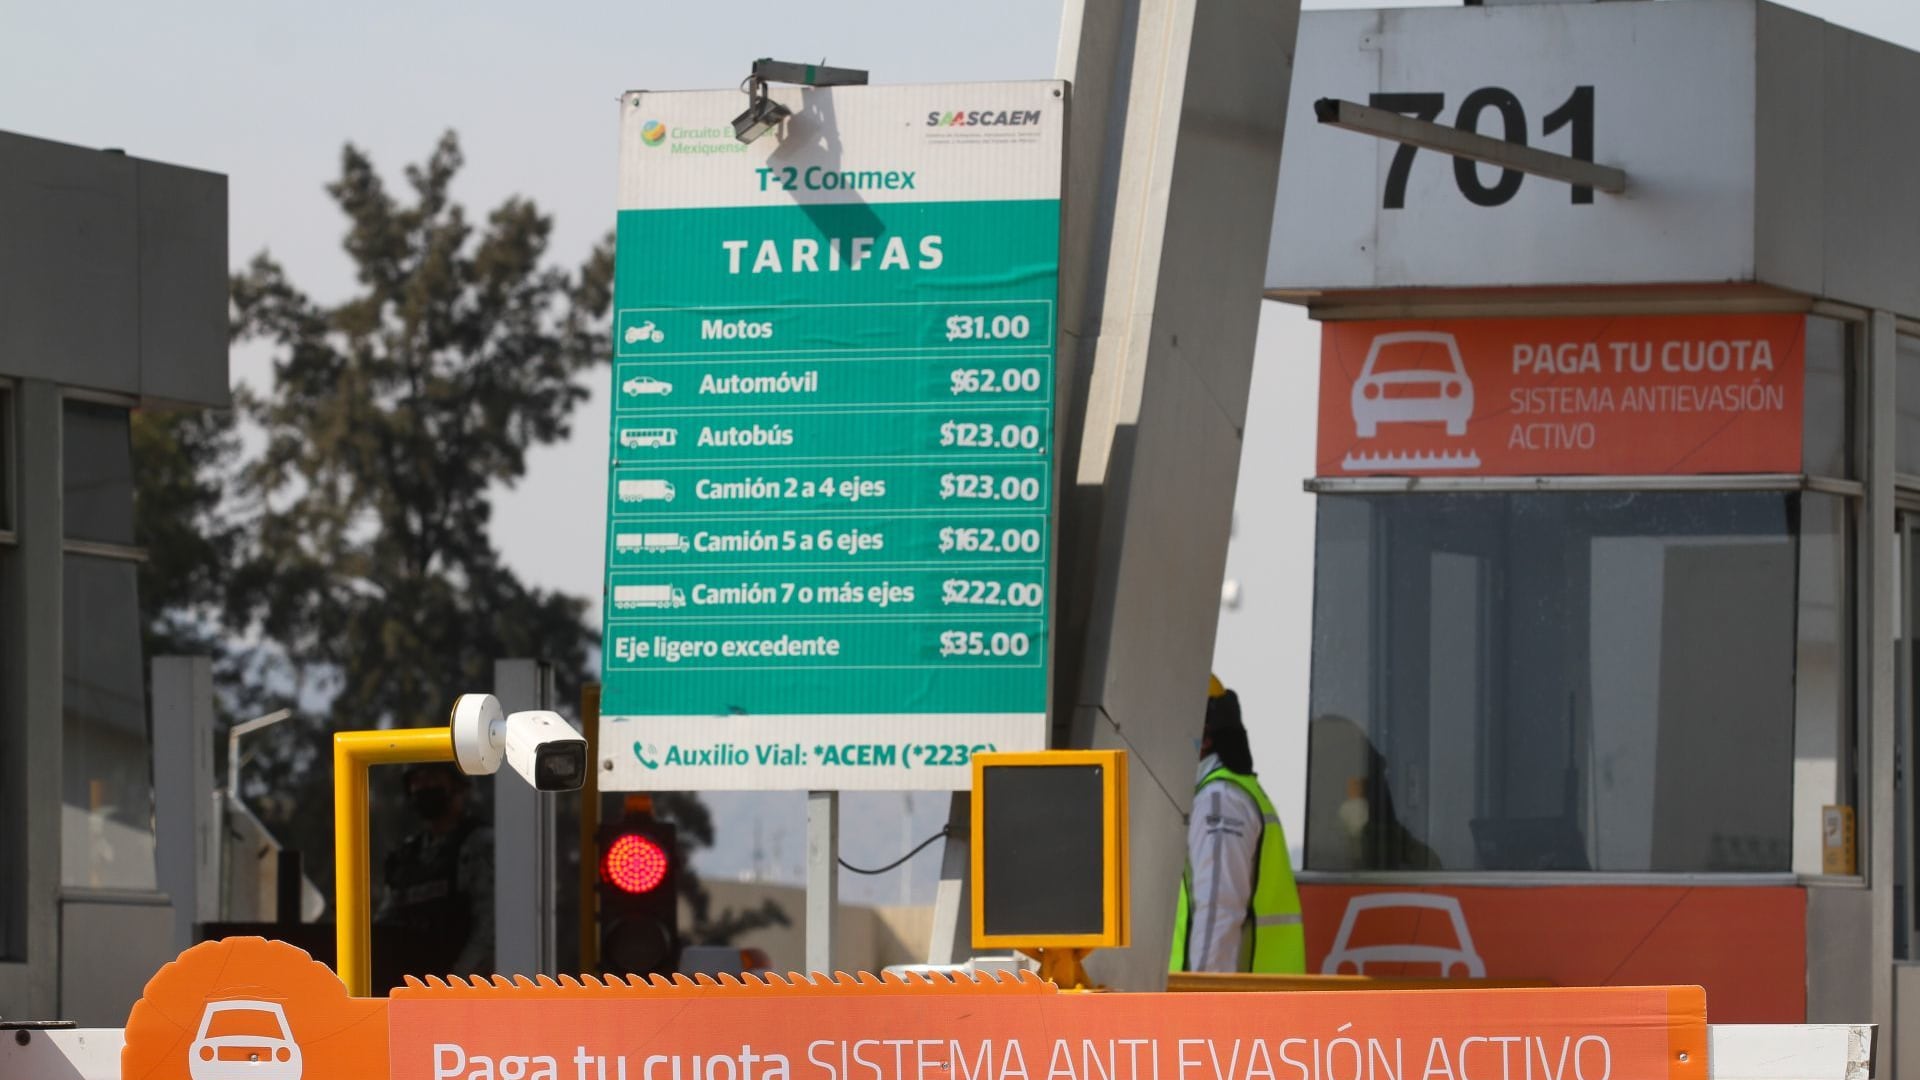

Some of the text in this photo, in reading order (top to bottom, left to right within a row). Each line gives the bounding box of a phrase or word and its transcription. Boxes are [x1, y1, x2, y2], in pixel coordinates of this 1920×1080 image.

[926, 110, 1041, 127] SAASCAEM
[670, 126, 721, 140] Circuito
[1369, 85, 1595, 209] 701
[671, 143, 748, 156] Mexiquense
[756, 165, 914, 191] T-2 Conmex
[723, 235, 943, 274] TARIFAS
[702, 315, 1029, 341] Motos $31.00
[1513, 341, 1773, 374] PAGA TU CUOTA
[700, 368, 1040, 395] Automóvil $62.00
[1510, 379, 1783, 414] SISTEMA ANTIEVASIÓN
[698, 420, 1039, 448] Autobús $123.00
[1508, 423, 1595, 449] ACTIVO
[696, 473, 1039, 501] Camión 2 a 4 ejes $123.00
[694, 527, 1040, 555] Camión 5 a 6 ejes $162.00
[692, 579, 1042, 607] Camión 7 o más ejes $222.00
[616, 631, 1029, 662] Eje ligero excedente $35.00
[665, 744, 749, 765] Auxilio
[756, 744, 806, 765] Vial:
[808, 1039, 1029, 1080] SISTEMA
[1423, 1035, 1610, 1080] ACTIVO
